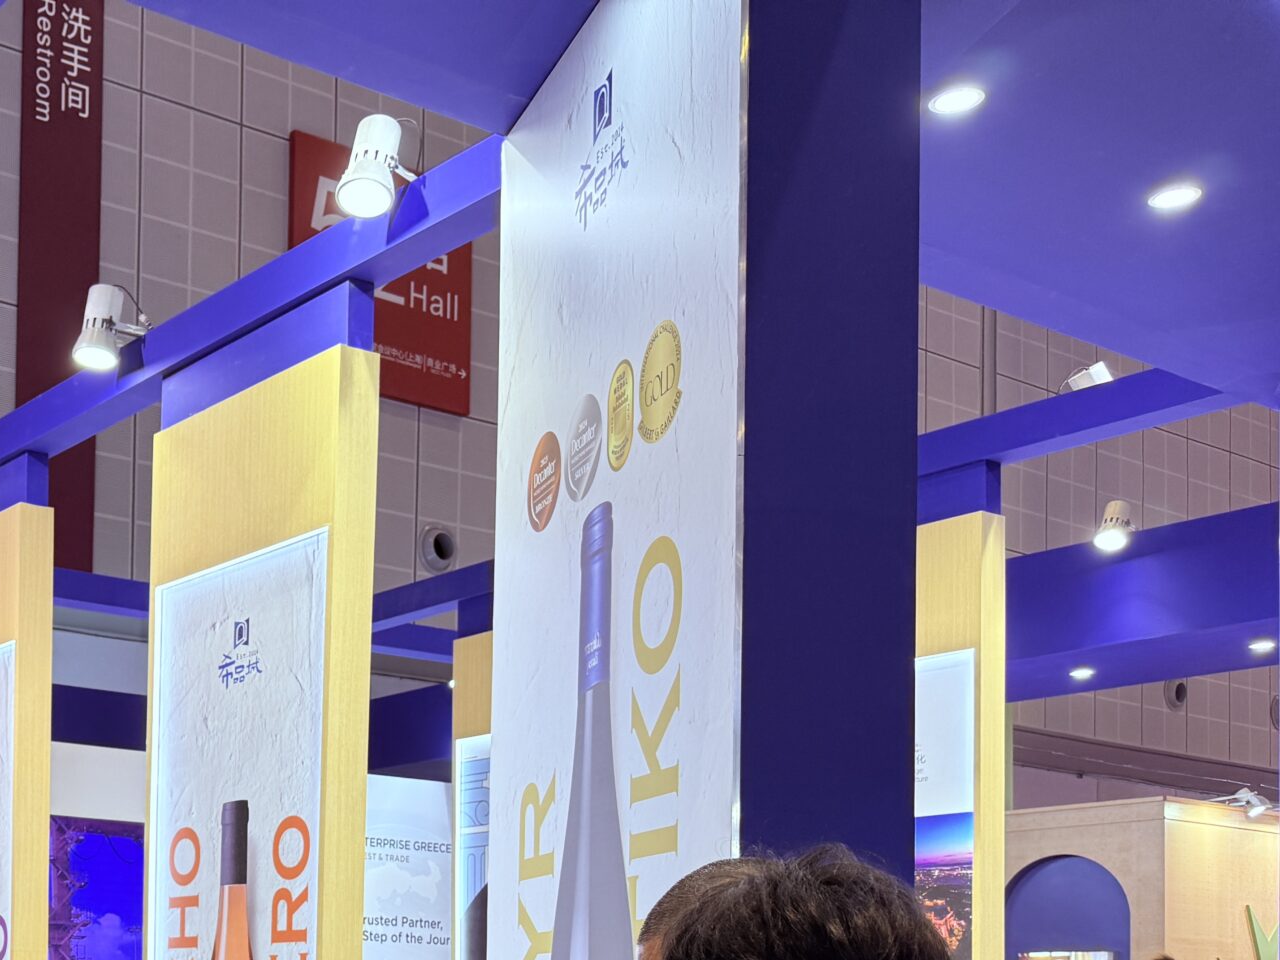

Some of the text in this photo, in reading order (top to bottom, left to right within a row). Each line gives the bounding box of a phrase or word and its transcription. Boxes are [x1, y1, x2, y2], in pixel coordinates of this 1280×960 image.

[36, 0, 56, 122] Restroom
[61, 3, 92, 118] 洗手间
[409, 281, 459, 322] Hall
[645, 363, 676, 408] GOLD
[571, 423, 597, 456] Decanter
[534, 459, 556, 489] Decanter
[365, 837, 452, 854] TERPRISE GREECE
[385, 854, 410, 863] TRADE
[363, 916, 443, 931] rusted Partner,
[363, 930, 450, 946] Step of the Jour
